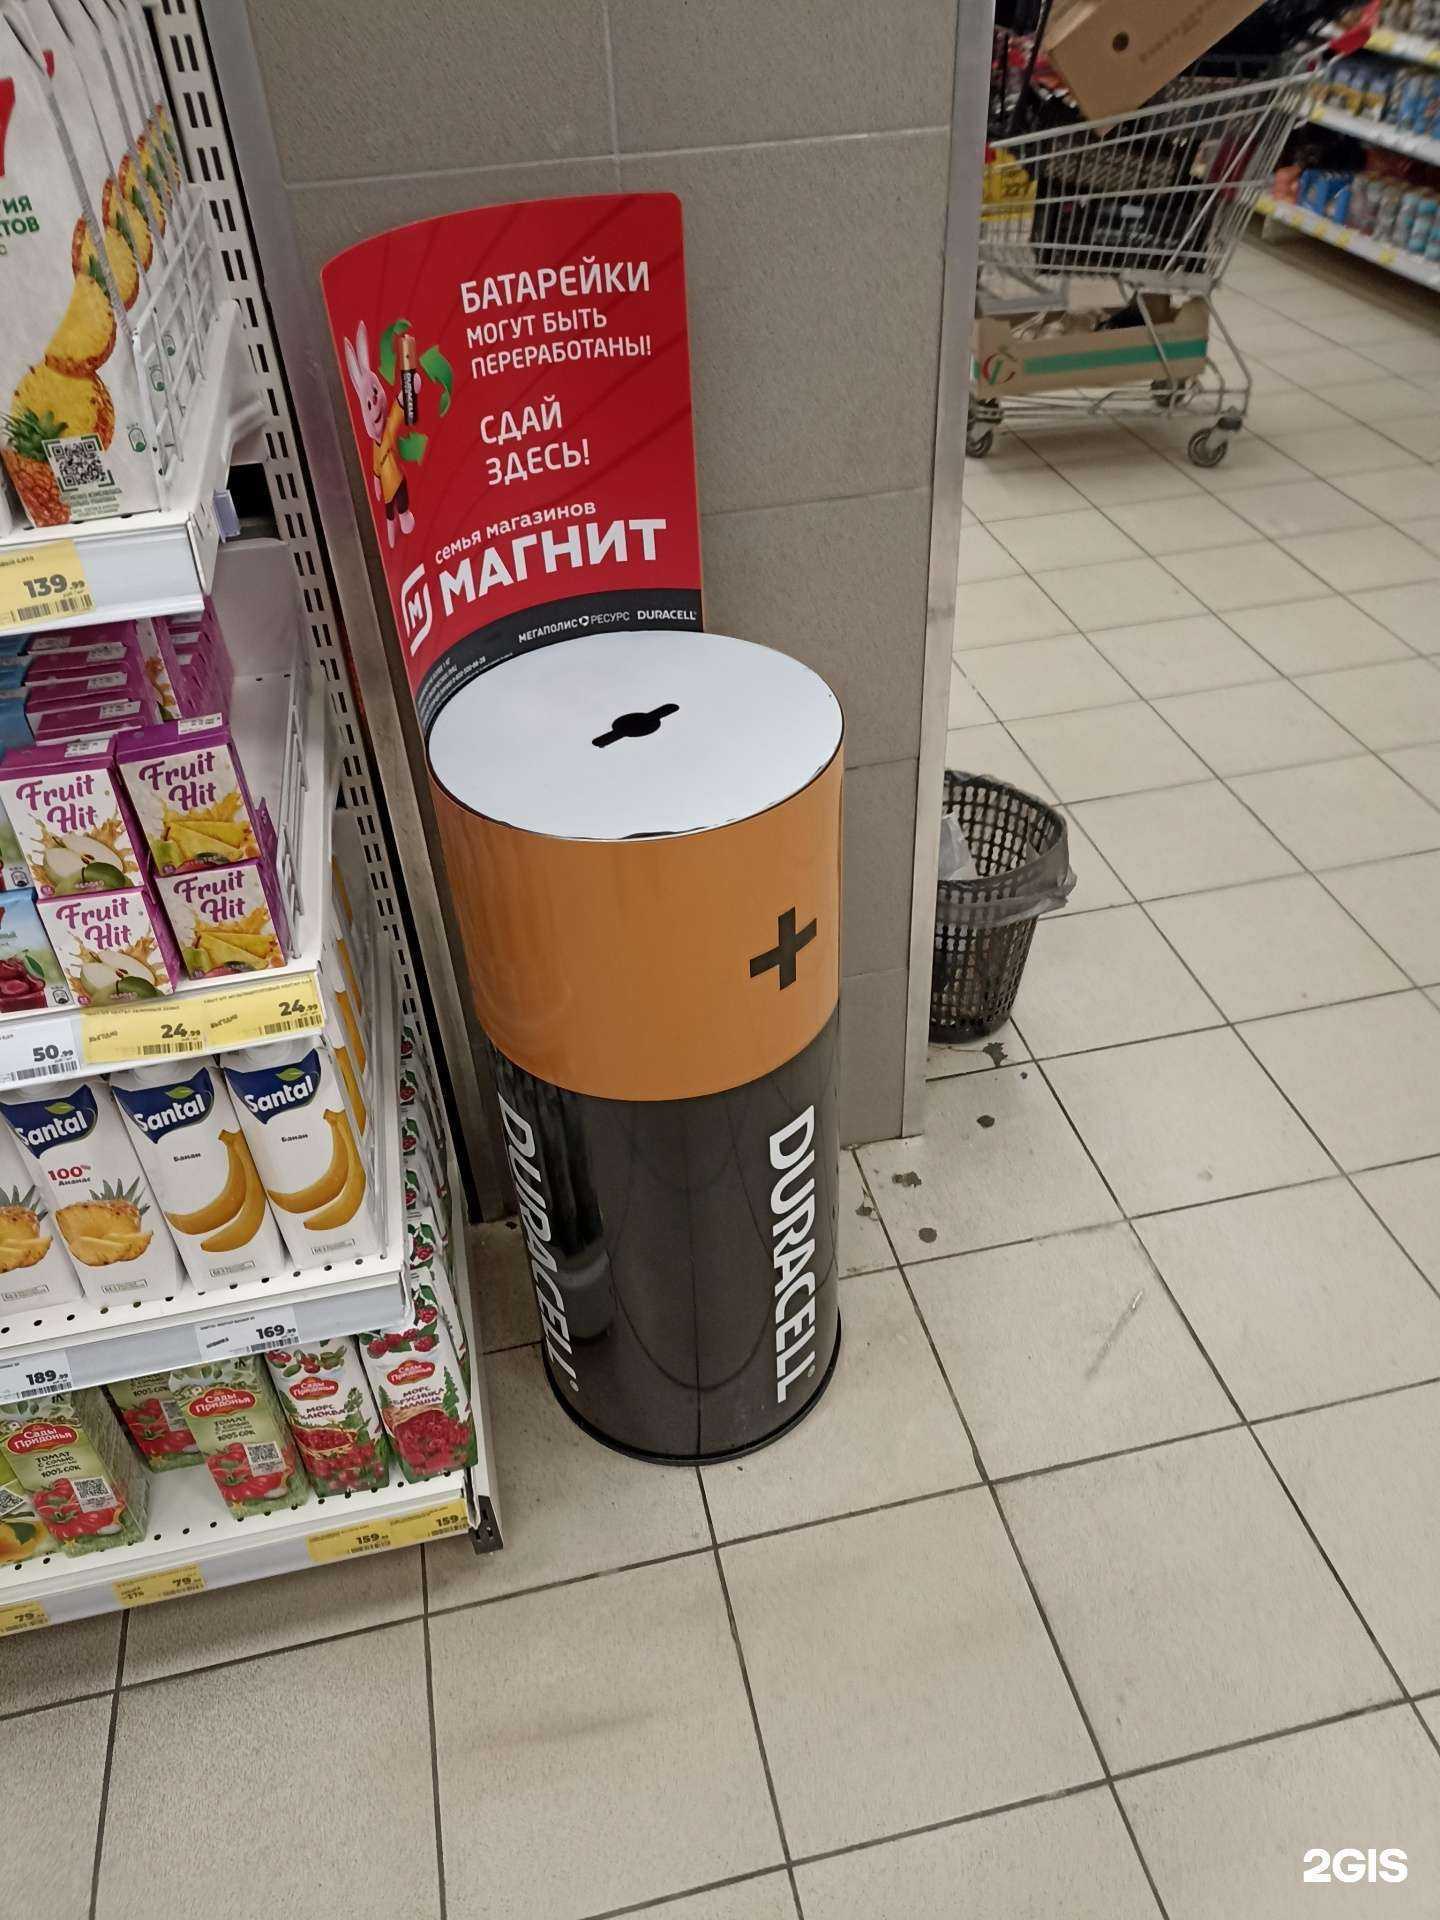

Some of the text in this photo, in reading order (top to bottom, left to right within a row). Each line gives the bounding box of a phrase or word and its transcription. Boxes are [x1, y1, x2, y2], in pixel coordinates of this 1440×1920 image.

[460, 256, 650, 314] БАТАРЕЙКИ
[466, 309, 608, 349] МОГУТ БЫТЬ
[470, 335, 652, 379] ПЕРЕРАБОТАНЫ!
[480, 395, 563, 446] СДАЙ
[486, 438, 592, 487] ЗДЕСЬ!
[434, 501, 597, 565] семья магазинов
[438, 518, 668, 617] МАГНИТ
[518, 611, 631, 644] МЕГАПОЛИС РЕСУРС
[637, 609, 697, 621] DURACELL
[138, 751, 216, 791] Fruit
[15, 773, 95, 811] Fruit
[168, 782, 217, 811] Hit
[46, 804, 97, 834] Hit
[173, 869, 246, 904] Fruit
[55, 896, 130, 930] Fruit
[200, 897, 246, 923] Hit
[84, 922, 131, 951] Hit
[244, 1074, 314, 1113] Santal
[133, 1093, 206, 1132] Santal
[769, 1104, 816, 1404] DURACELL
[194, 1396, 251, 1413] Придонья
[204, 1392, 237, 1404] Сады
[14, 1431, 73, 1449] Придонья
[23, 1428, 58, 1439] Сады
[35, 1451, 72, 1463] ТОМАТ
